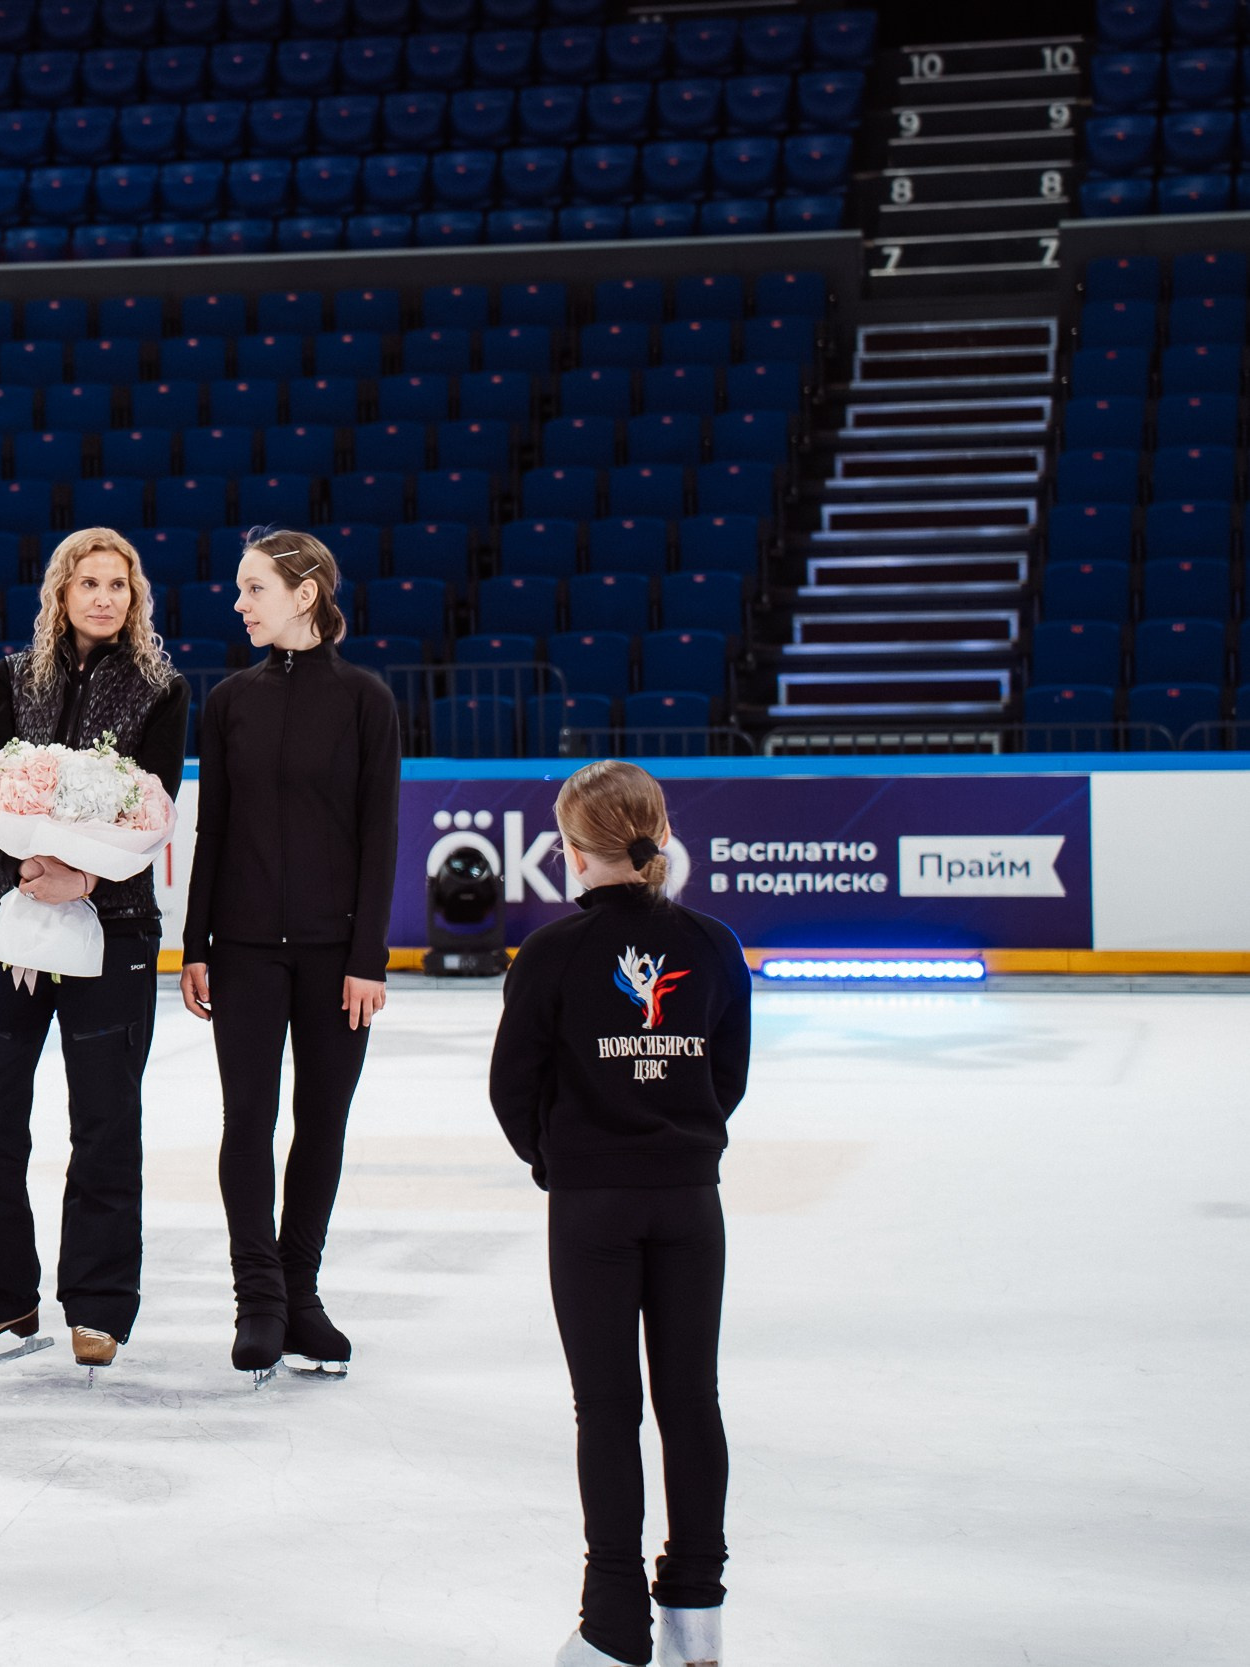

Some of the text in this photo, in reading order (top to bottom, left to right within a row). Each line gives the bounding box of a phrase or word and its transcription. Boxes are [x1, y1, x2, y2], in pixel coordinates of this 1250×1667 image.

[911, 54, 943, 78] 10
[1042, 46, 1075, 70] 10
[899, 112, 920, 136] 9
[1049, 103, 1070, 128] 9
[890, 178, 913, 203] 8
[1040, 171, 1062, 197] 8
[881, 246, 902, 271] 7
[1038, 238, 1059, 265] 7
[711, 838, 877, 862] Бесплатно
[919, 852, 1031, 883] Прайм
[711, 872, 888, 896] в подписке
[598, 1035, 705, 1058] НОВОСИБИРСК
[633, 1060, 668, 1084] ЦЗВС
